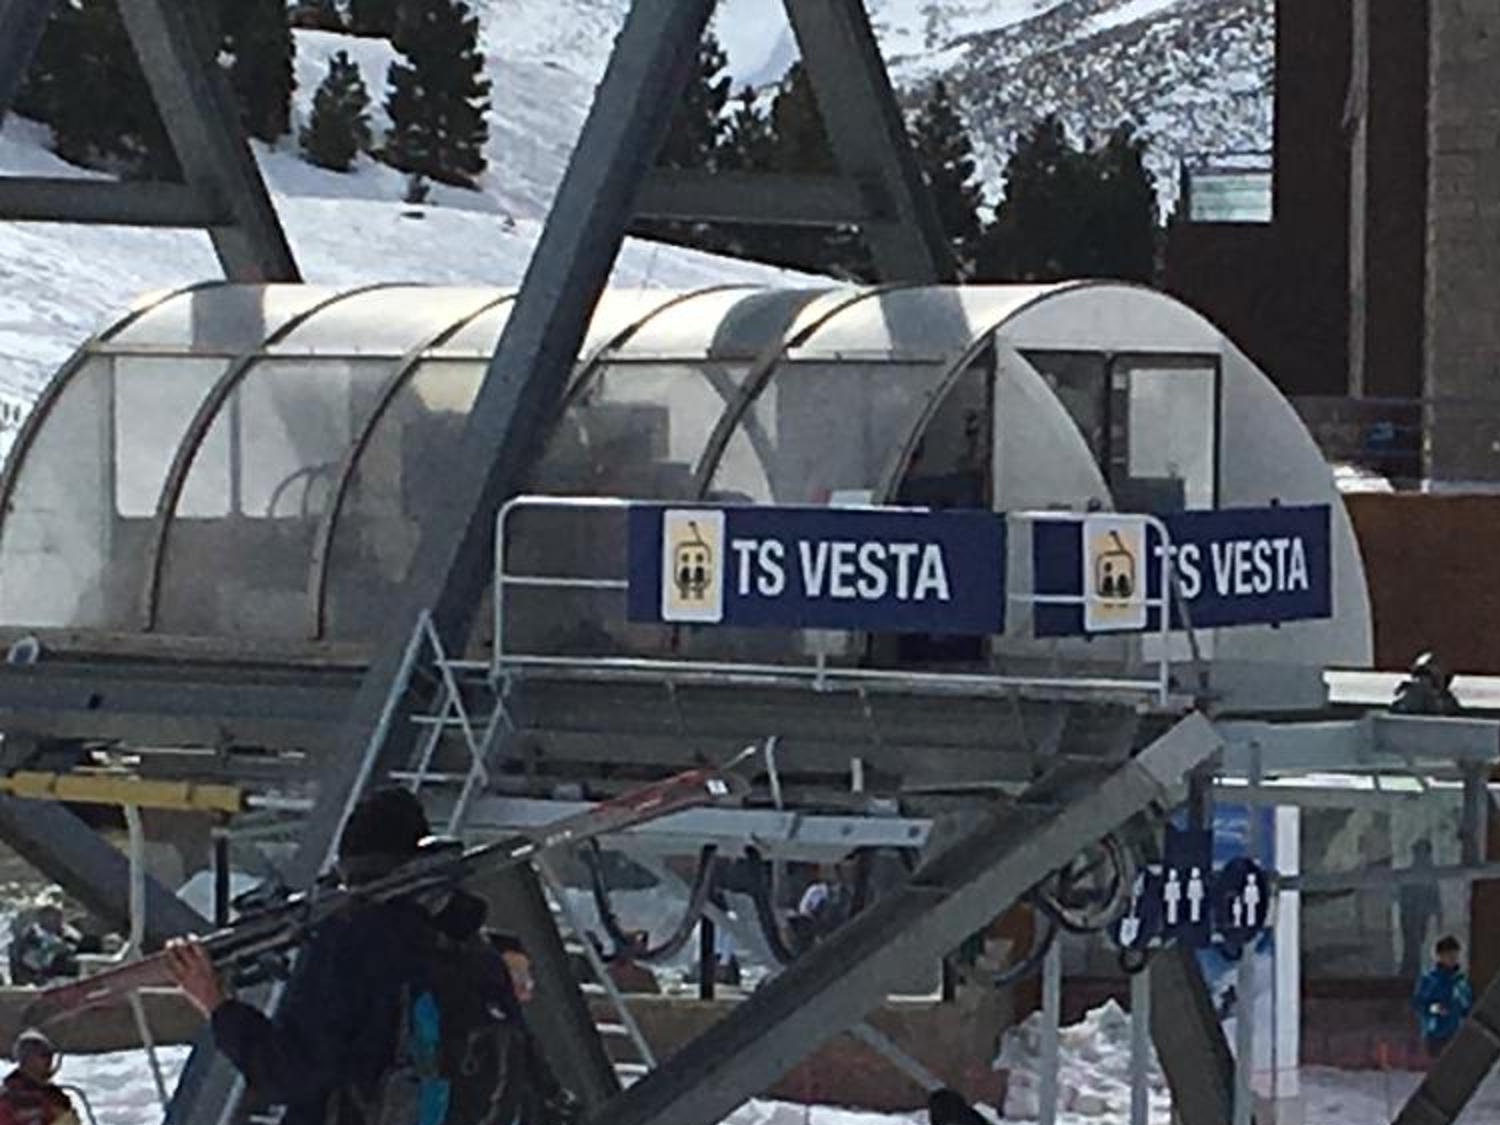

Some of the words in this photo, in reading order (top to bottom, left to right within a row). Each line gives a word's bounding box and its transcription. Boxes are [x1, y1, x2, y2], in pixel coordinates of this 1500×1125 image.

[732, 539, 785, 596] TS
[799, 541, 950, 600] VESTA
[1154, 543, 1201, 599] S
[1211, 536, 1309, 596] VESTA
